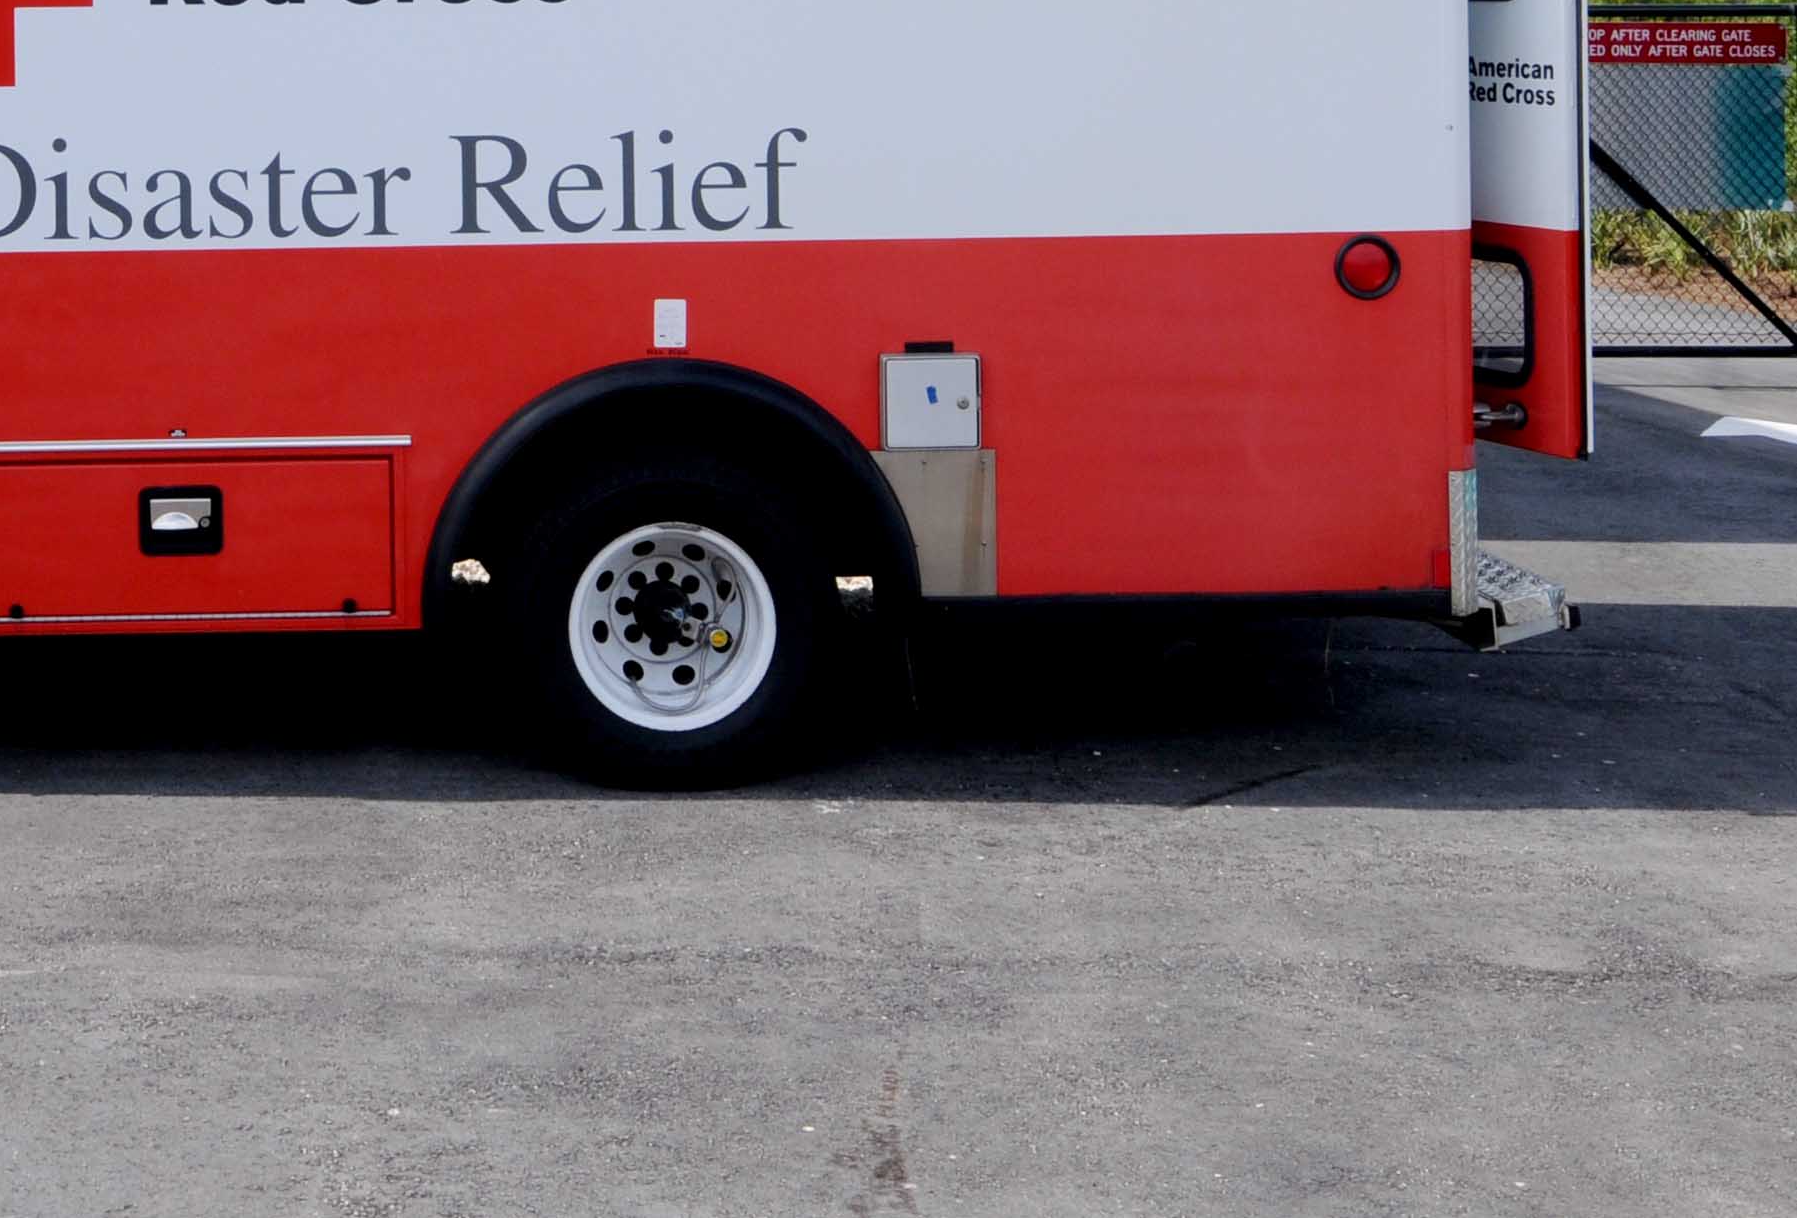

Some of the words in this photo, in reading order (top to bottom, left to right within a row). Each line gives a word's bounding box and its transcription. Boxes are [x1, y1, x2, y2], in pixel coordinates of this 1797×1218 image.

[1588, 29, 1605, 41] OP
[1610, 29, 1650, 41] AFTER
[1656, 29, 1716, 42] CLEARING
[1722, 29, 1752, 42] GATE
[1589, 44, 1606, 57] ED
[1611, 44, 1643, 57] ONLY
[1648, 44, 1688, 57] AFTER
[1693, 44, 1723, 57] GATE
[1729, 44, 1776, 58] CLOSES
[1469, 55, 1554, 80] American
[1502, 82, 1555, 106] Cross
[449, 129, 808, 234] Relief
